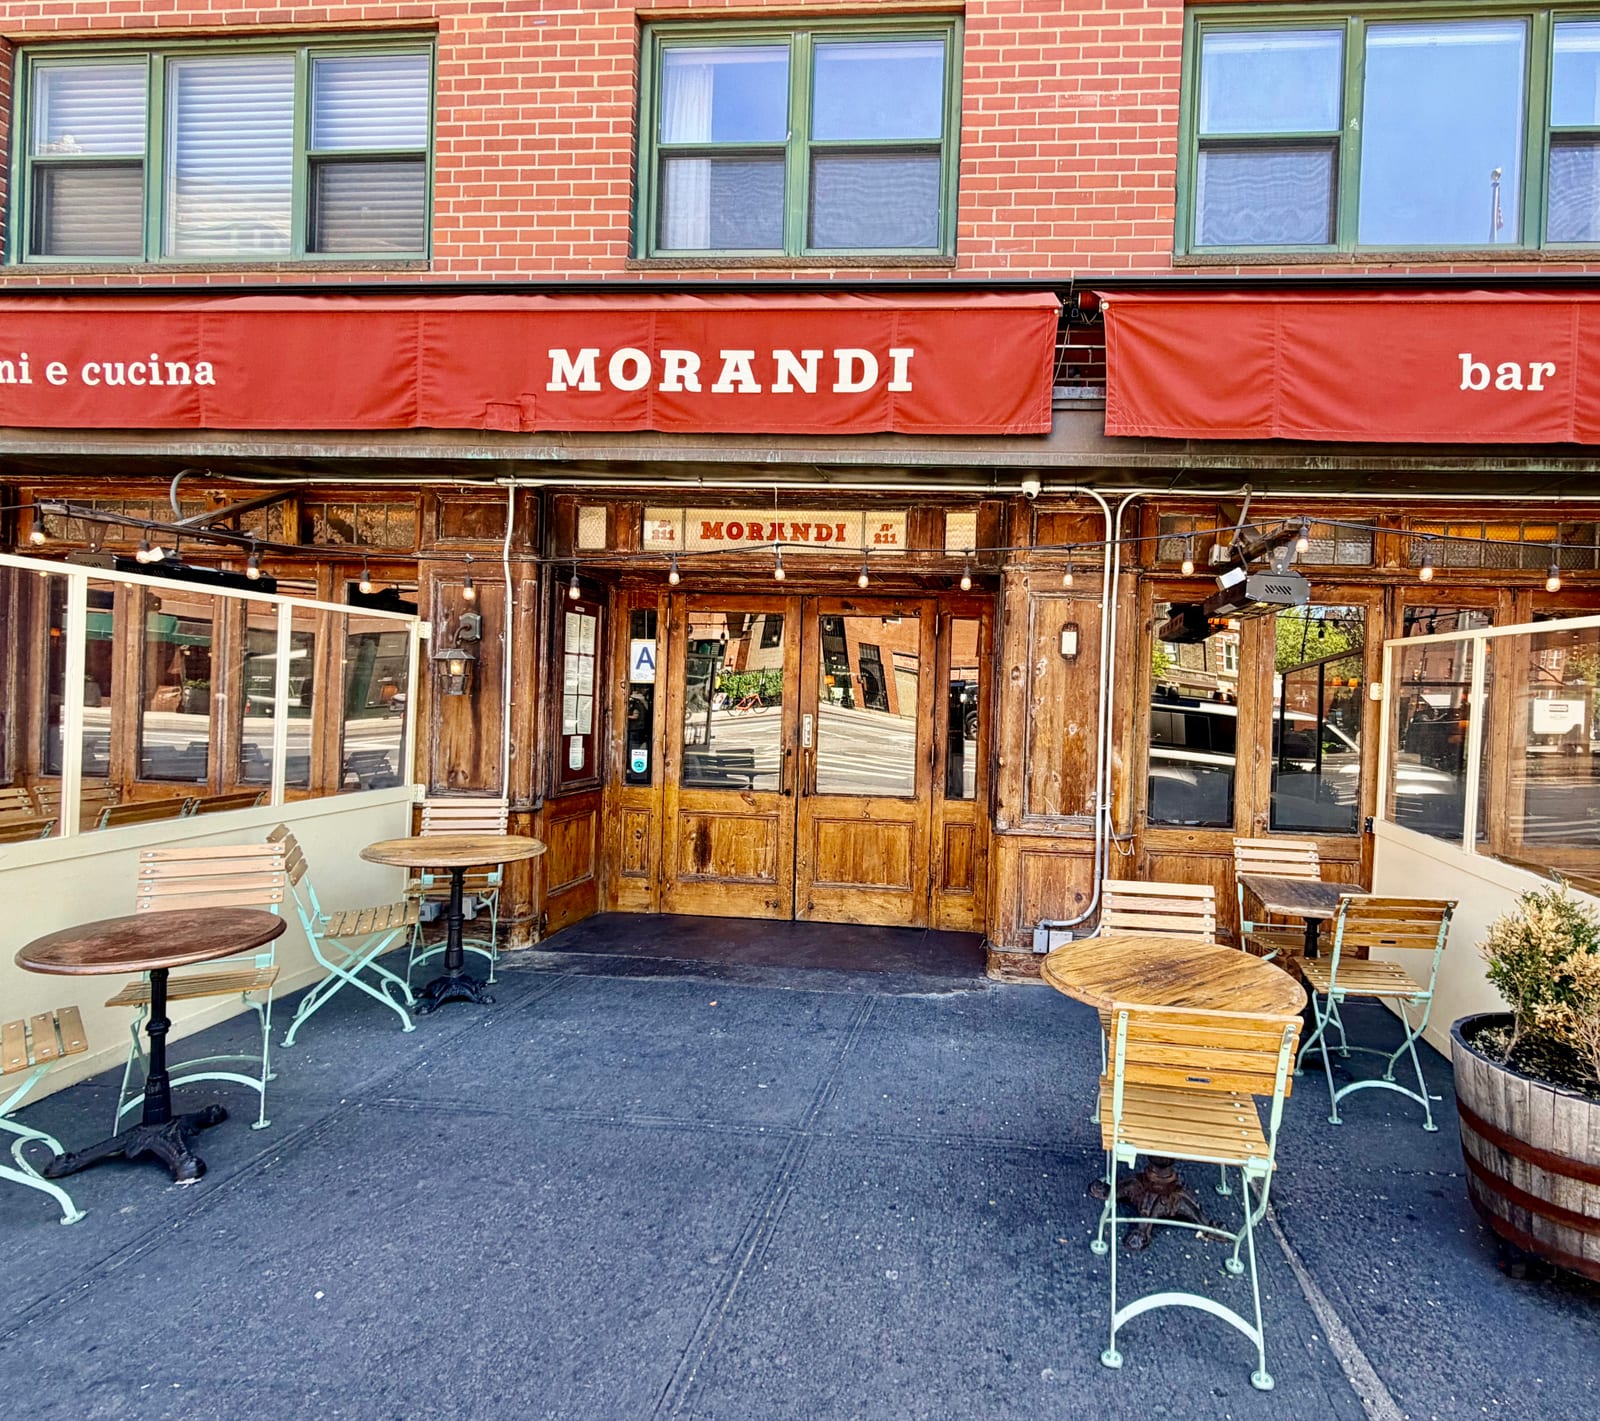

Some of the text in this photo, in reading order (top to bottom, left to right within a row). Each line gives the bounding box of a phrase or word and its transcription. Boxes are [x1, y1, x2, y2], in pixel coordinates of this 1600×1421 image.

[0, 352, 216, 388] ni e cucina
[546, 347, 915, 393] MORANDI
[1458, 353, 1556, 391] bar
[652, 529, 675, 541] 211
[700, 521, 847, 542] MORANDI
[873, 533, 898, 544] 211
[635, 646, 656, 670] A
